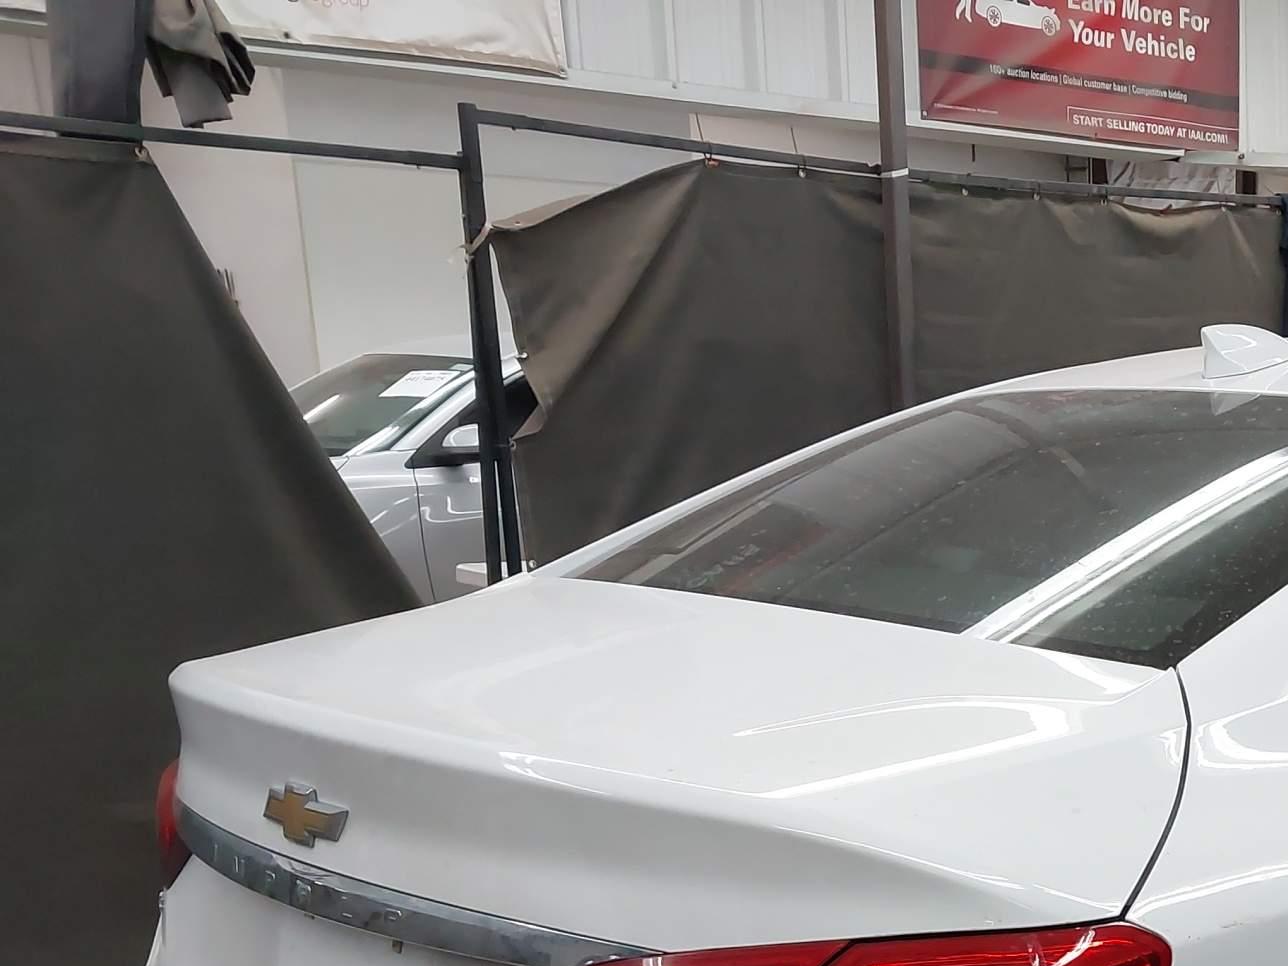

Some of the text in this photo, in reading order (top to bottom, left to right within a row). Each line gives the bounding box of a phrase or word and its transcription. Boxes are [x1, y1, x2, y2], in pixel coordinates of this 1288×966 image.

[1121, 0, 1173, 27] More
[1179, 7, 1210, 33] For
[1068, 19, 1197, 62] Your Vehicle
[1006, 66, 1030, 79] auction
[1030, 69, 1059, 83] locations
[1062, 74, 1083, 87] Global
[1083, 78, 1113, 91] customer
[1112, 82, 1128, 93] base
[1131, 84, 1167, 98] Competitive
[1167, 89, 1188, 103] bidding
[1072, 114, 1104, 128] START
[1106, 118, 1145, 133] SELLING
[1146, 122, 1176, 137] TODAY
[1176, 128, 1188, 139] AT
